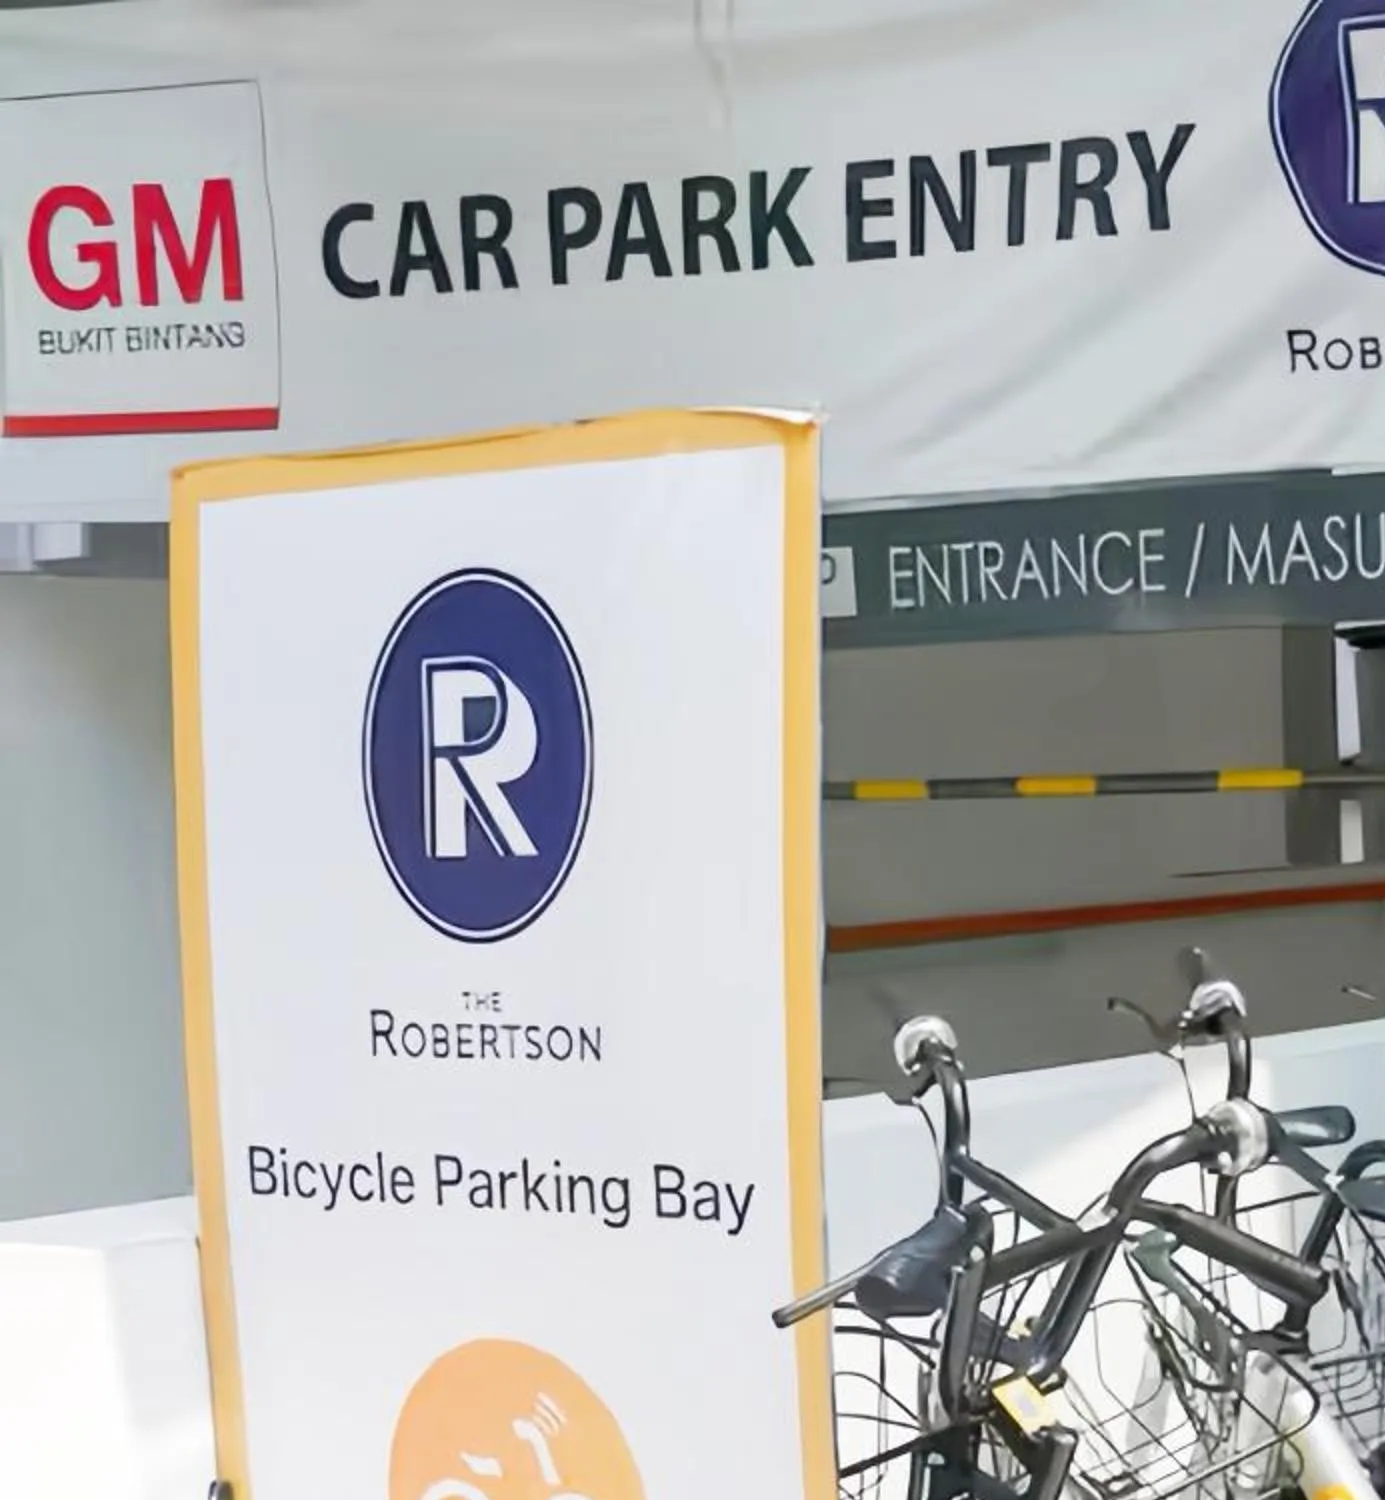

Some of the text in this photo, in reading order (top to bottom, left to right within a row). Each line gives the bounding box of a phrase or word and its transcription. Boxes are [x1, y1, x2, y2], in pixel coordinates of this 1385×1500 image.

[28, 179, 241, 309] GM
[322, 123, 1196, 299] CAR PARK ENTRY
[39, 321, 246, 354] BUKIT BINTANG
[890, 528, 1166, 607] ENTRANCE
[369, 1008, 601, 1062] ROBERTSON
[461, 991, 502, 1013] THE
[249, 1146, 754, 1235] Bicycle Parking Bay
